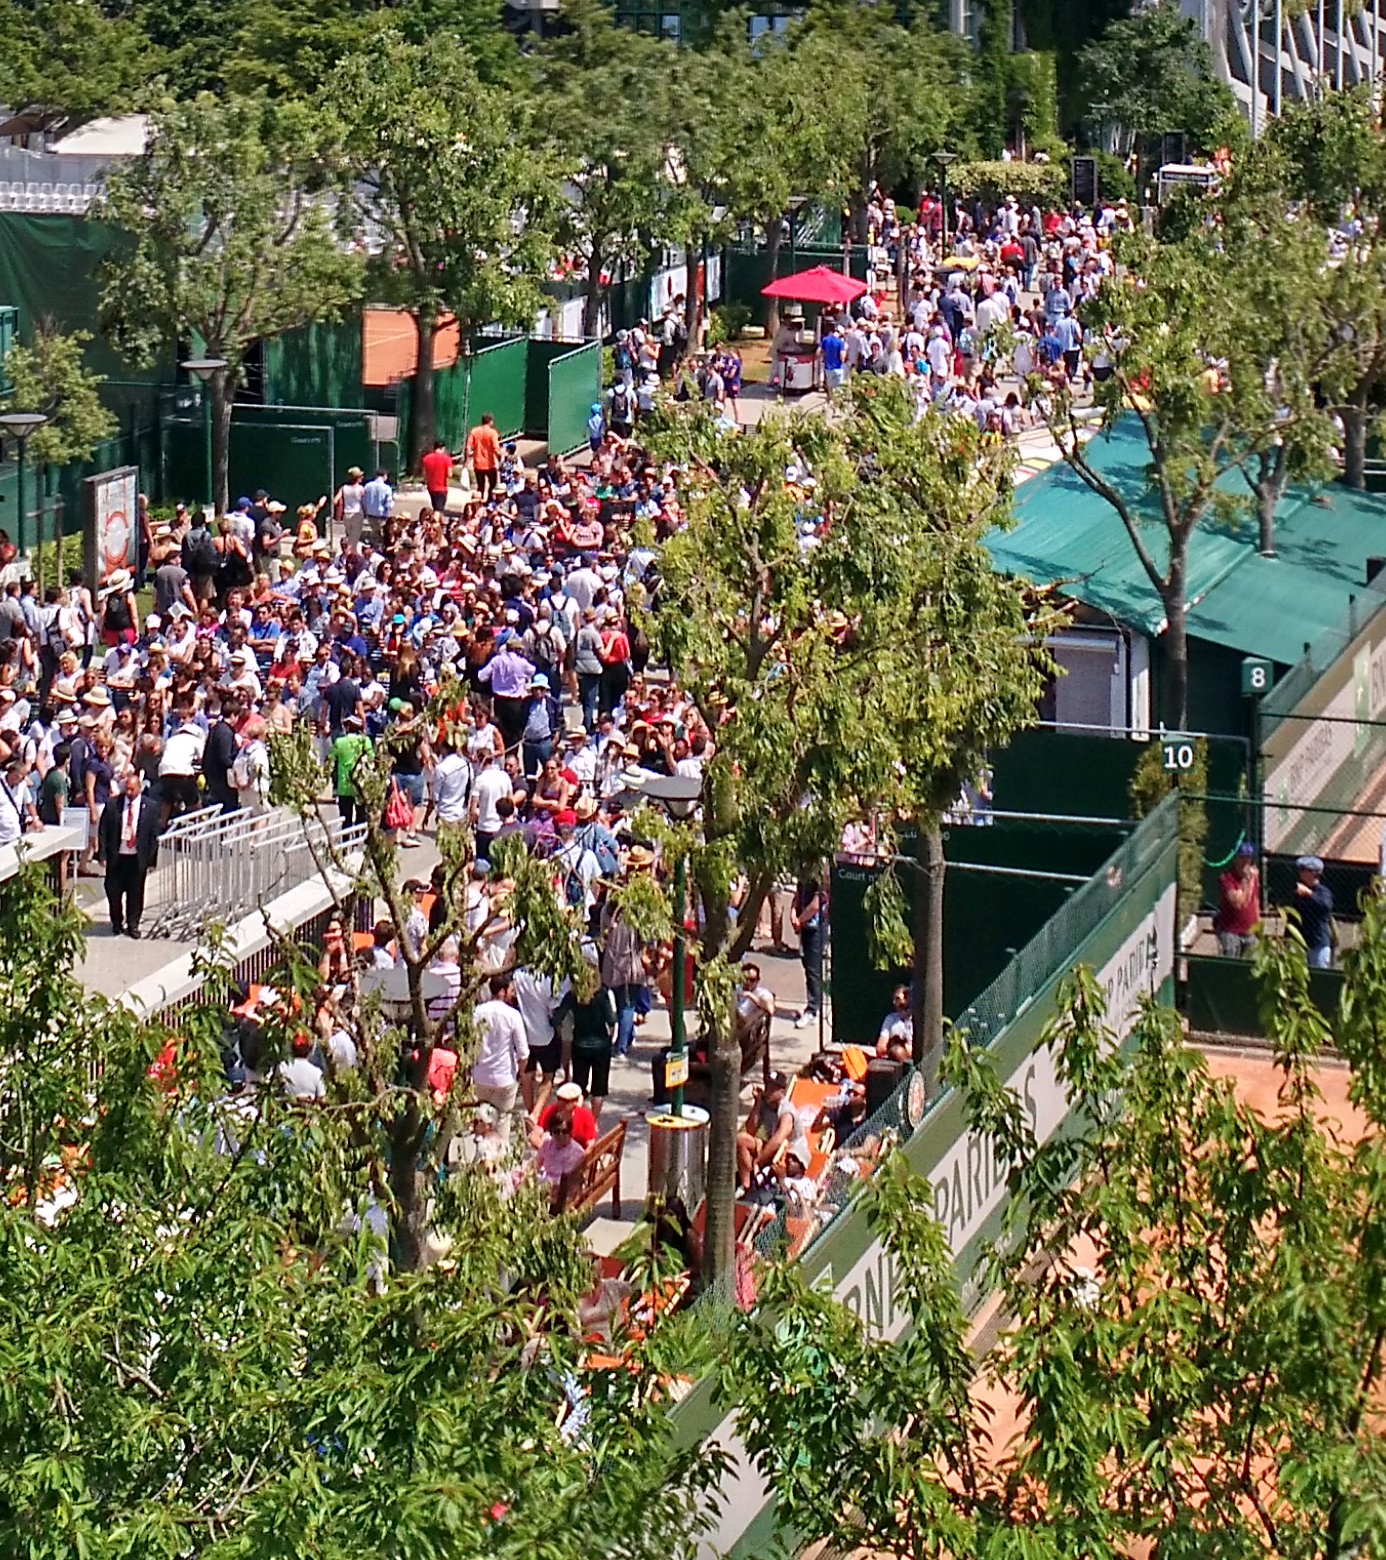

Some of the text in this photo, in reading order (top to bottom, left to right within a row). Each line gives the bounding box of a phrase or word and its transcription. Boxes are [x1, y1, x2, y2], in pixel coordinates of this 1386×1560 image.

[1251, 666, 1266, 688] 8
[1163, 745, 1194, 769] 10
[838, 868, 866, 881] Court
[933, 1064, 1037, 1247] PARIBS
